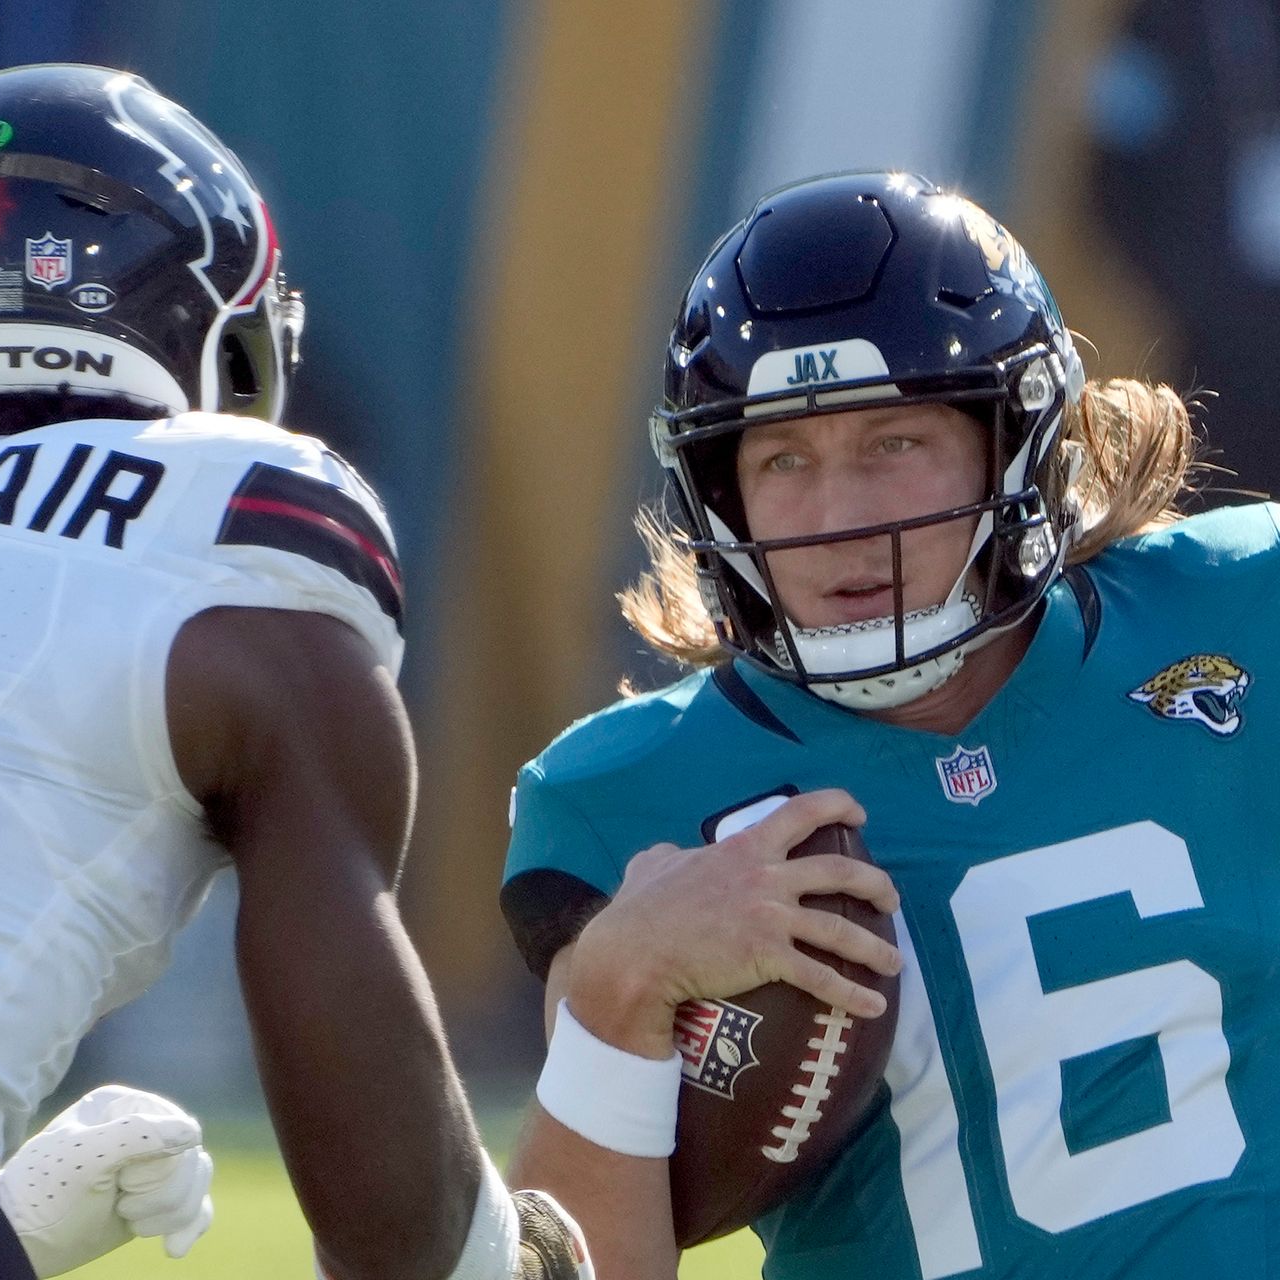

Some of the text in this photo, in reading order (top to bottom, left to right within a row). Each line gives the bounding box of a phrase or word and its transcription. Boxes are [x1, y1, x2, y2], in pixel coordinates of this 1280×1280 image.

[32, 257, 66, 280] NFL
[786, 349, 841, 385] JAX
[951, 768, 988, 794] NFL
